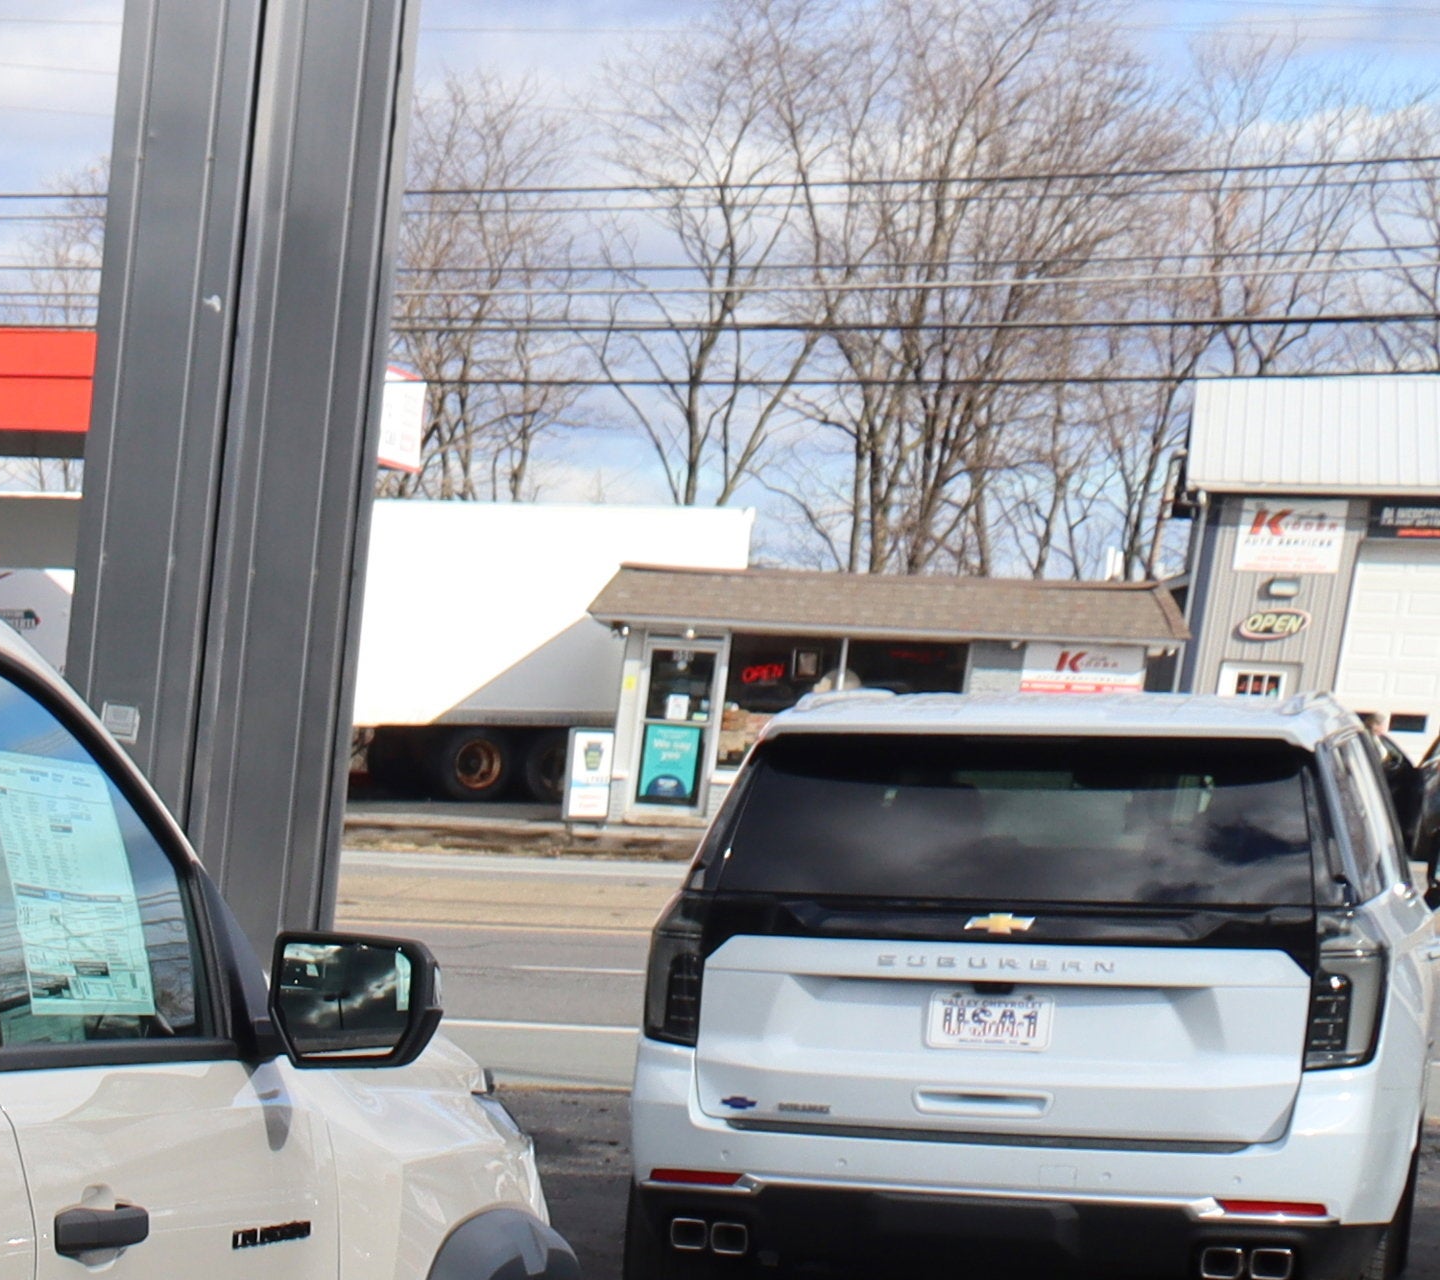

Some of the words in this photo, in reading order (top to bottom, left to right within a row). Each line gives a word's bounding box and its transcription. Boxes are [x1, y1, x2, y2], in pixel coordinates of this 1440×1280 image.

[1245, 613, 1305, 634] OPEN
[741, 663, 785, 685] OPEN
[877, 954, 1115, 974] SUBURBAN
